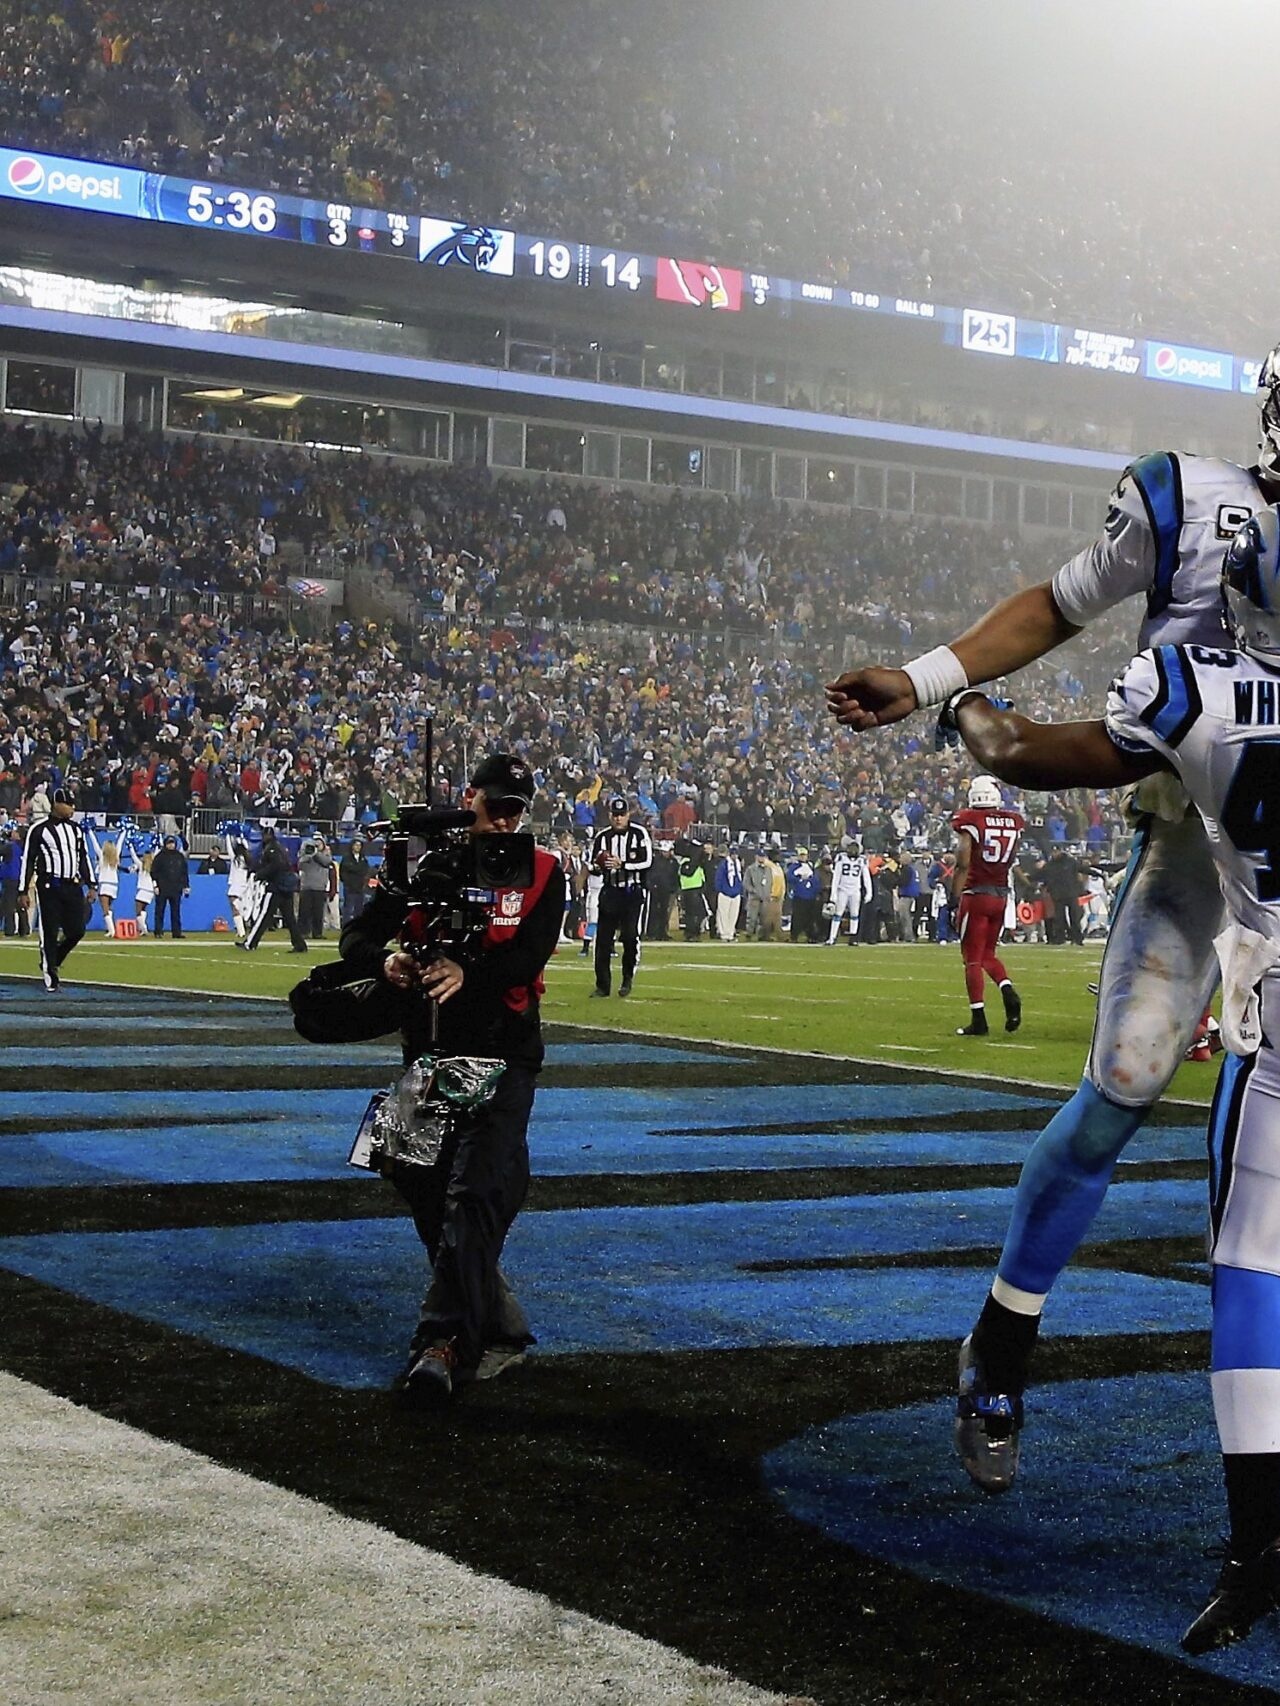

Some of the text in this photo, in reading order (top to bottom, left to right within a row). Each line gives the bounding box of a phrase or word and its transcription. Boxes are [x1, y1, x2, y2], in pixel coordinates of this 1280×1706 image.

[47, 173, 122, 200] pepsi
[187, 186, 277, 232] 5:36
[327, 203, 352, 221] QTR
[328, 219, 348, 247] 3
[391, 229, 405, 247] 3
[528, 240, 572, 280] 19
[600, 254, 641, 290] 14
[754, 289, 767, 306] 3
[970, 322, 1008, 350] 25
[1178, 356, 1223, 380] pepsi
[983, 829, 1017, 864] 57
[842, 863, 862, 877] 23
[504, 903, 520, 913] NFL
[119, 921, 135, 938] 10
